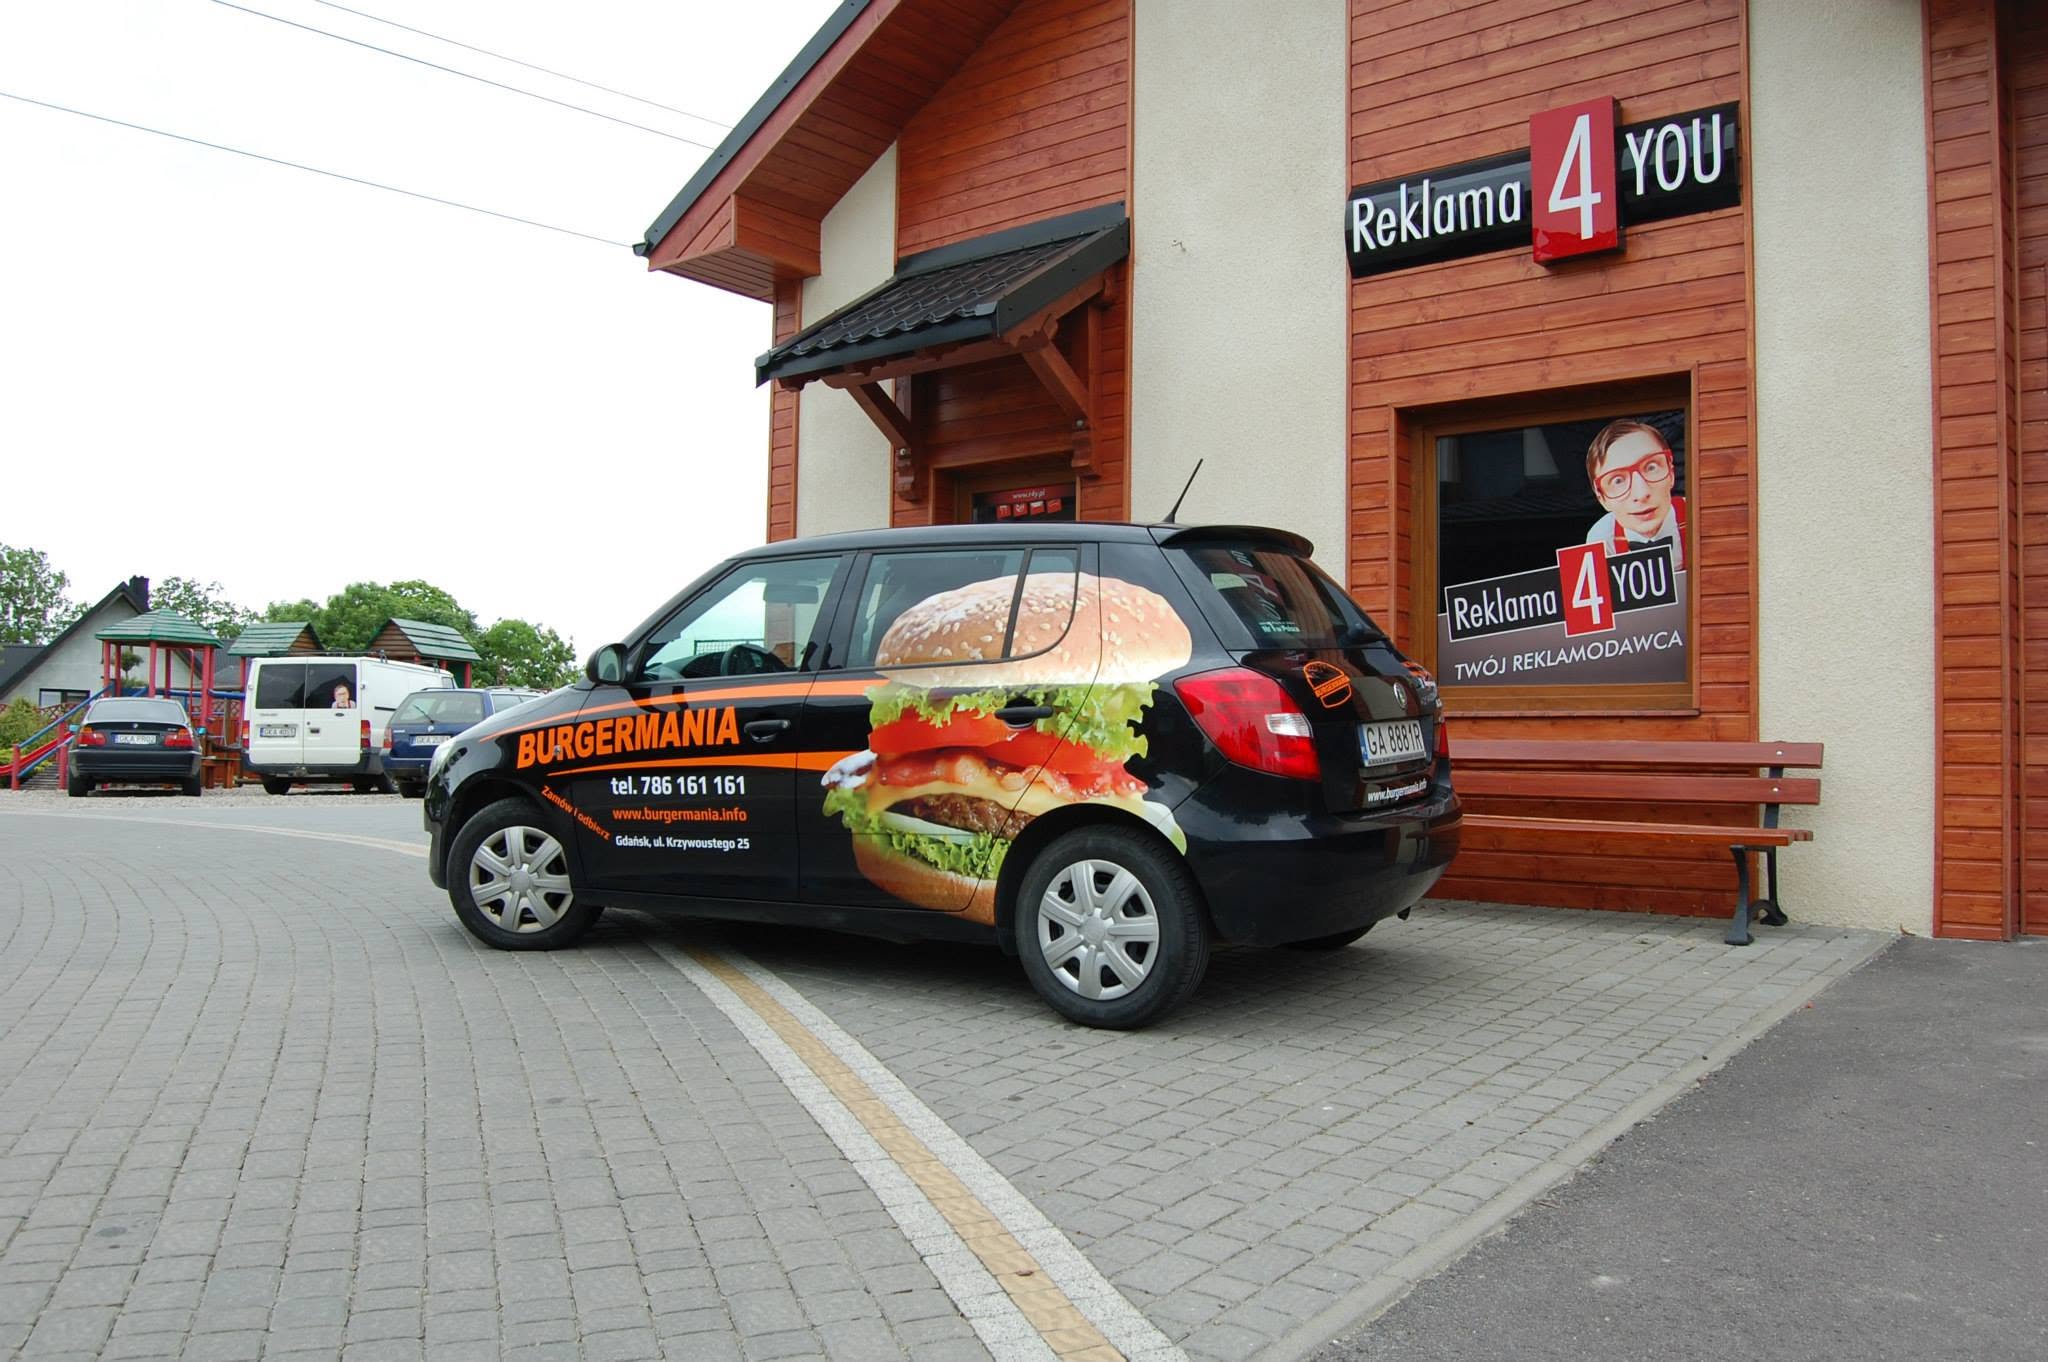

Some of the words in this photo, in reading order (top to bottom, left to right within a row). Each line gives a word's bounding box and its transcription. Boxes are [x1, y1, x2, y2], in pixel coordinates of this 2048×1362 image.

[1353, 178, 1521, 252] Reklama
[1548, 113, 1602, 240] 4
[1625, 113, 1722, 196] YOU
[1454, 587, 1557, 631] Reklama
[1571, 551, 1603, 625] 4
[1611, 556, 1666, 602] YOU
[1454, 655, 1506, 681] TWÓJ
[1512, 630, 1683, 671] REKLAMODAWCA
[516, 705, 740, 769] BURGERMANIA
[1366, 727, 1388, 755] GA
[1387, 723, 1423, 752] 8881R
[611, 776, 637, 795] tel.
[641, 776, 672, 795] 786
[677, 776, 707, 795] 161
[714, 776, 745, 795] 161
[541, 784, 573, 813] Zamów
[577, 813, 611, 840] odbierz
[612, 808, 748, 823] www.burgermania.info
[615, 835, 652, 848] Gdańsk,
[653, 836, 665, 847] ul.
[666, 837, 735, 851] Krzywoustego
[737, 838, 750, 849] 25
